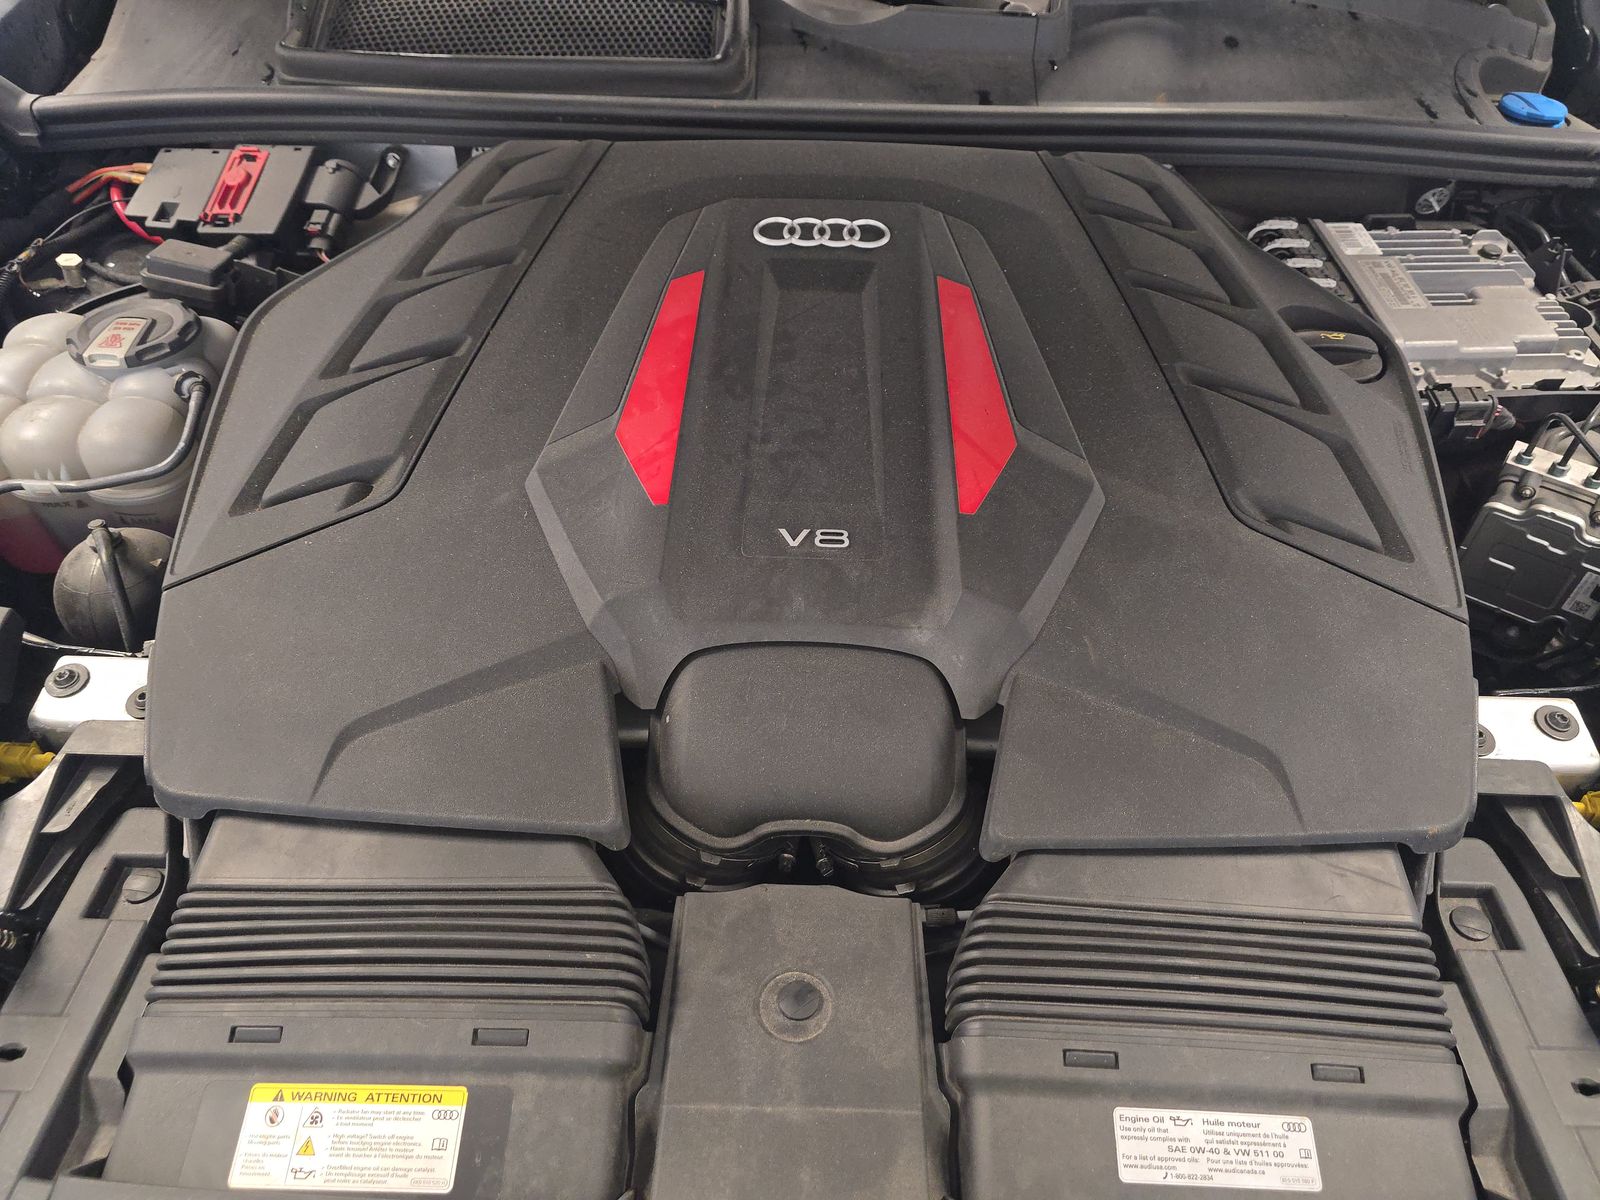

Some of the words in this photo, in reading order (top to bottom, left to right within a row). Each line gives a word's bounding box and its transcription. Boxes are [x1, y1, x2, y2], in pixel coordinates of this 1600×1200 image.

[778, 528, 850, 548] V8
[291, 1091, 357, 1102] WARNING
[365, 1092, 443, 1103] ATTENTION
[1119, 1114, 1149, 1124] Engine
[1152, 1115, 1165, 1124] Oil
[1202, 1118, 1225, 1127] Huile
[1227, 1120, 1261, 1129] moteur
[1120, 1134, 1148, 1142] expressly
[1149, 1135, 1176, 1143] complies
[1226, 1130, 1261, 1138] uniquement
[1271, 1132, 1289, 1140] l'huile
[1216, 1138, 1239, 1146] satisfait
[1240, 1139, 1282, 1148] expressément
[1167, 1145, 1188, 1154] SAE
[1189, 1146, 1220, 1155] 0W-40
[1223, 1148, 1230, 1156] &
[1233, 1148, 1250, 1157] VW
[1253, 1149, 1270, 1158] 511
[1272, 1150, 1285, 1159] 00
[1139, 1153, 1149, 1161] list
[1157, 1155, 1186, 1163] approved
[1206, 1157, 1221, 1165] Pour
[1235, 1158, 1248, 1166] liste
[1249, 1159, 1272, 1167] d'huiles
[1274, 1160, 1309, 1169] approuvées:
[1123, 1163, 1177, 1171] www.audiusa.com
[1208, 1167, 1265, 1175] www.audicanada.ca
[1170, 1173, 1214, 1181] 1-800-822-2834
